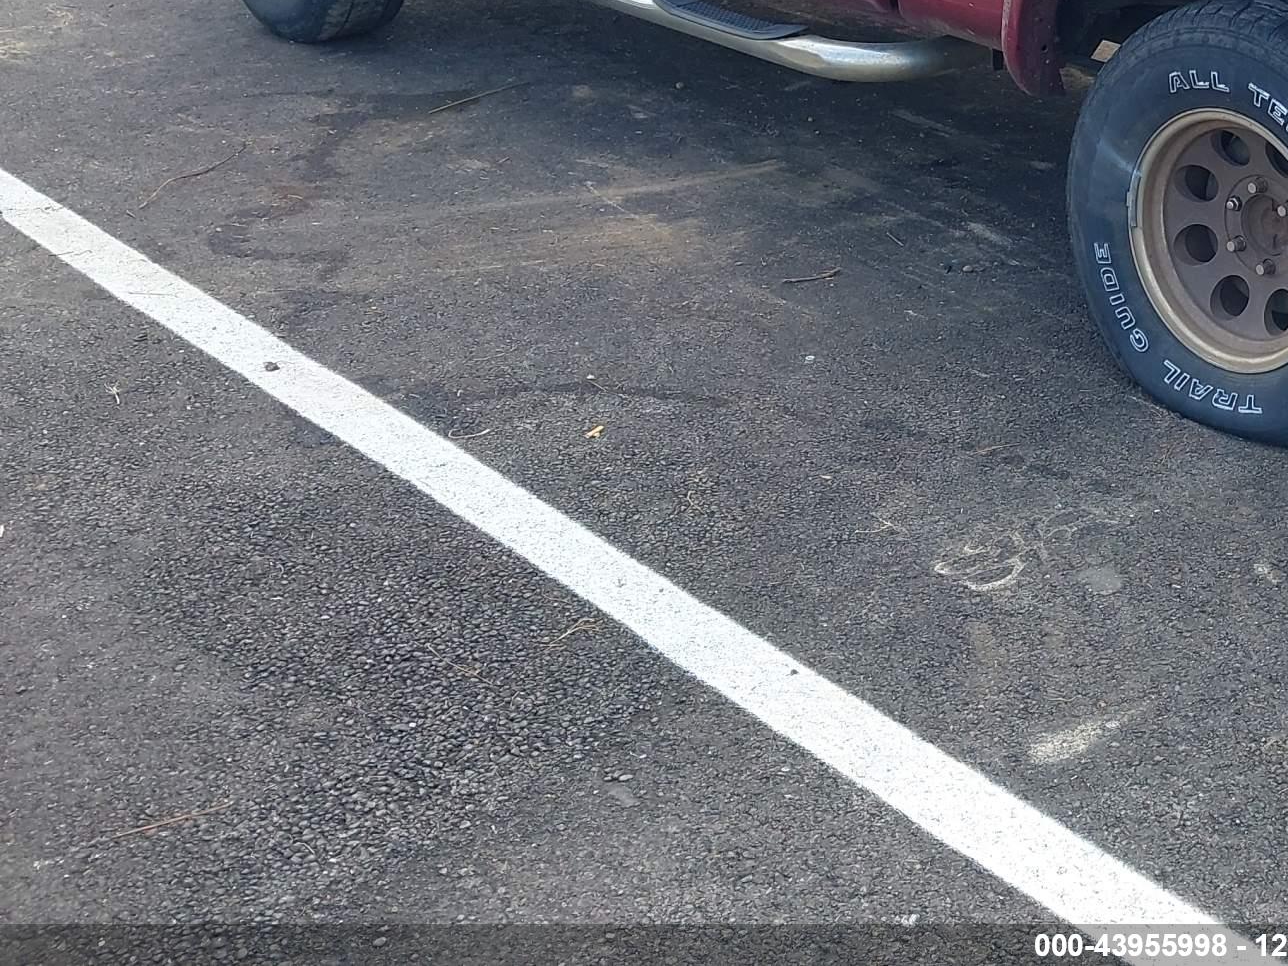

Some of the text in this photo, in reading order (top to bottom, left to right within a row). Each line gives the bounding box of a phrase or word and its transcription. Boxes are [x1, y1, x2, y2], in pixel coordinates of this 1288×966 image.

[1168, 70, 1230, 94] ALL
[1094, 241, 1264, 415] TRAIL GUIDE
